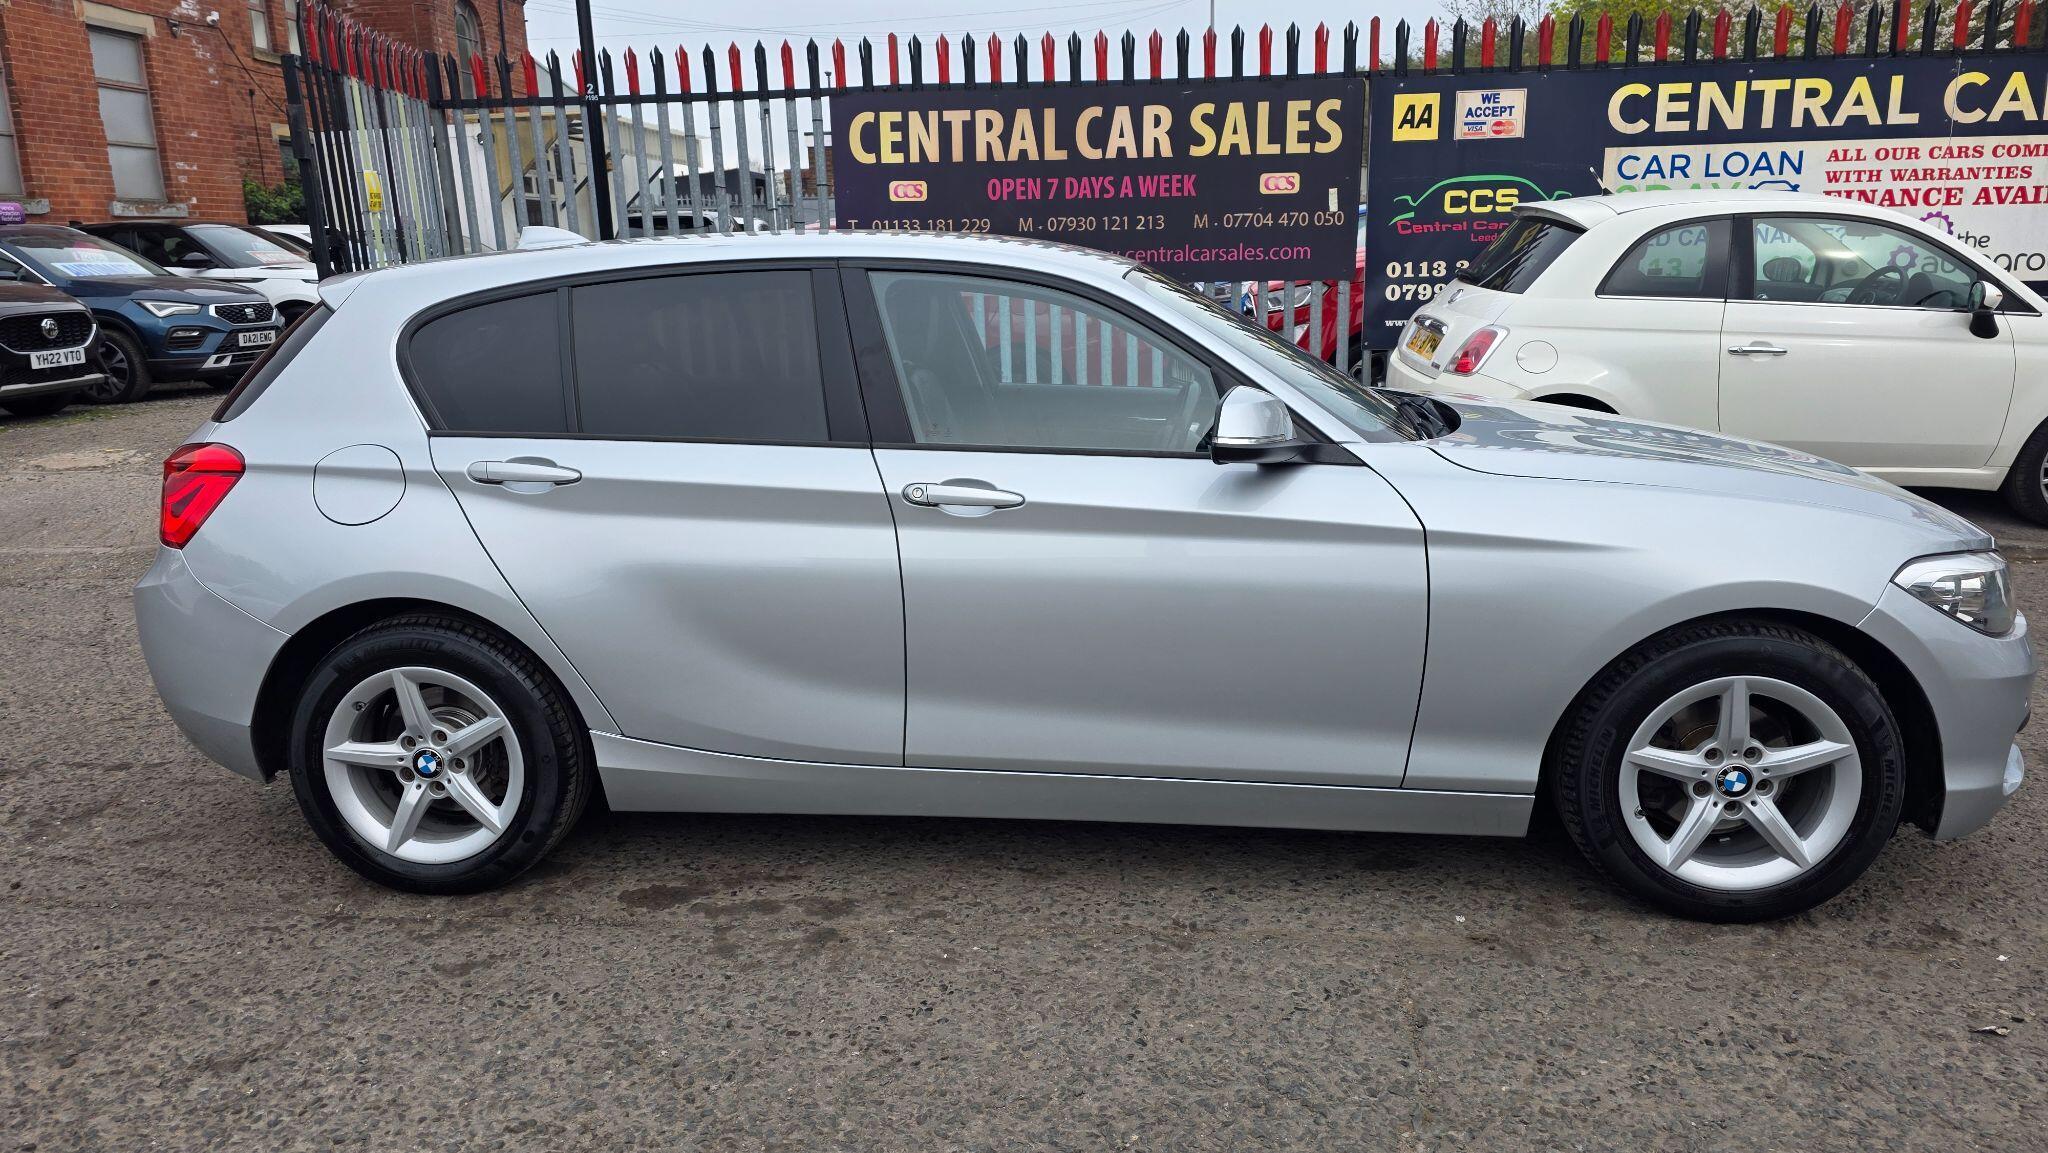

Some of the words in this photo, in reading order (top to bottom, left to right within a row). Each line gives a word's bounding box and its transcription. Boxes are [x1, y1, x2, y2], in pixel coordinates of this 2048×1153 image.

[586, 83, 594, 95] 2
[1481, 93, 1500, 104] WE
[1607, 75, 1920, 135] CENTRAL
[1943, 71, 2048, 124] CA
[1398, 104, 1433, 129] AA
[1465, 105, 1515, 118] ACCEPT
[848, 108, 1067, 164] CENTRAL
[1075, 105, 1173, 160] CAR
[1189, 99, 1343, 157] SALES
[1826, 148, 1867, 162] ALL
[1874, 146, 1921, 161] OUR
[1928, 145, 1985, 160] CARS
[1617, 153, 1691, 180] CAR
[1704, 150, 1804, 178] LOAN
[1825, 169, 1883, 183] WITH
[1890, 165, 2033, 182] WARRANTIES
[987, 177, 1041, 201] OPEN
[1048, 177, 1060, 200] 7
[1066, 175, 1115, 200] DAYS
[1120, 175, 1133, 198] A
[1138, 174, 1197, 198] WEEK
[1444, 188, 1519, 214] CCS
[928, 218, 954, 231] 181
[961, 218, 991, 233] 229
[1018, 217, 1033, 232] M
[1047, 216, 1096, 231] 07930
[1102, 215, 1129, 231] 121
[1135, 214, 1165, 231] 213
[1193, 213, 1209, 229] M
[1223, 212, 1273, 228] 07704
[1278, 211, 1309, 227] 470
[1314, 210, 1345, 226] 050
[1397, 220, 1467, 235] Central
[1473, 220, 1510, 230] Car
[1386, 260, 1447, 278] 0113
[35, 352, 62, 366] YH22
[64, 350, 82, 363] VTO
